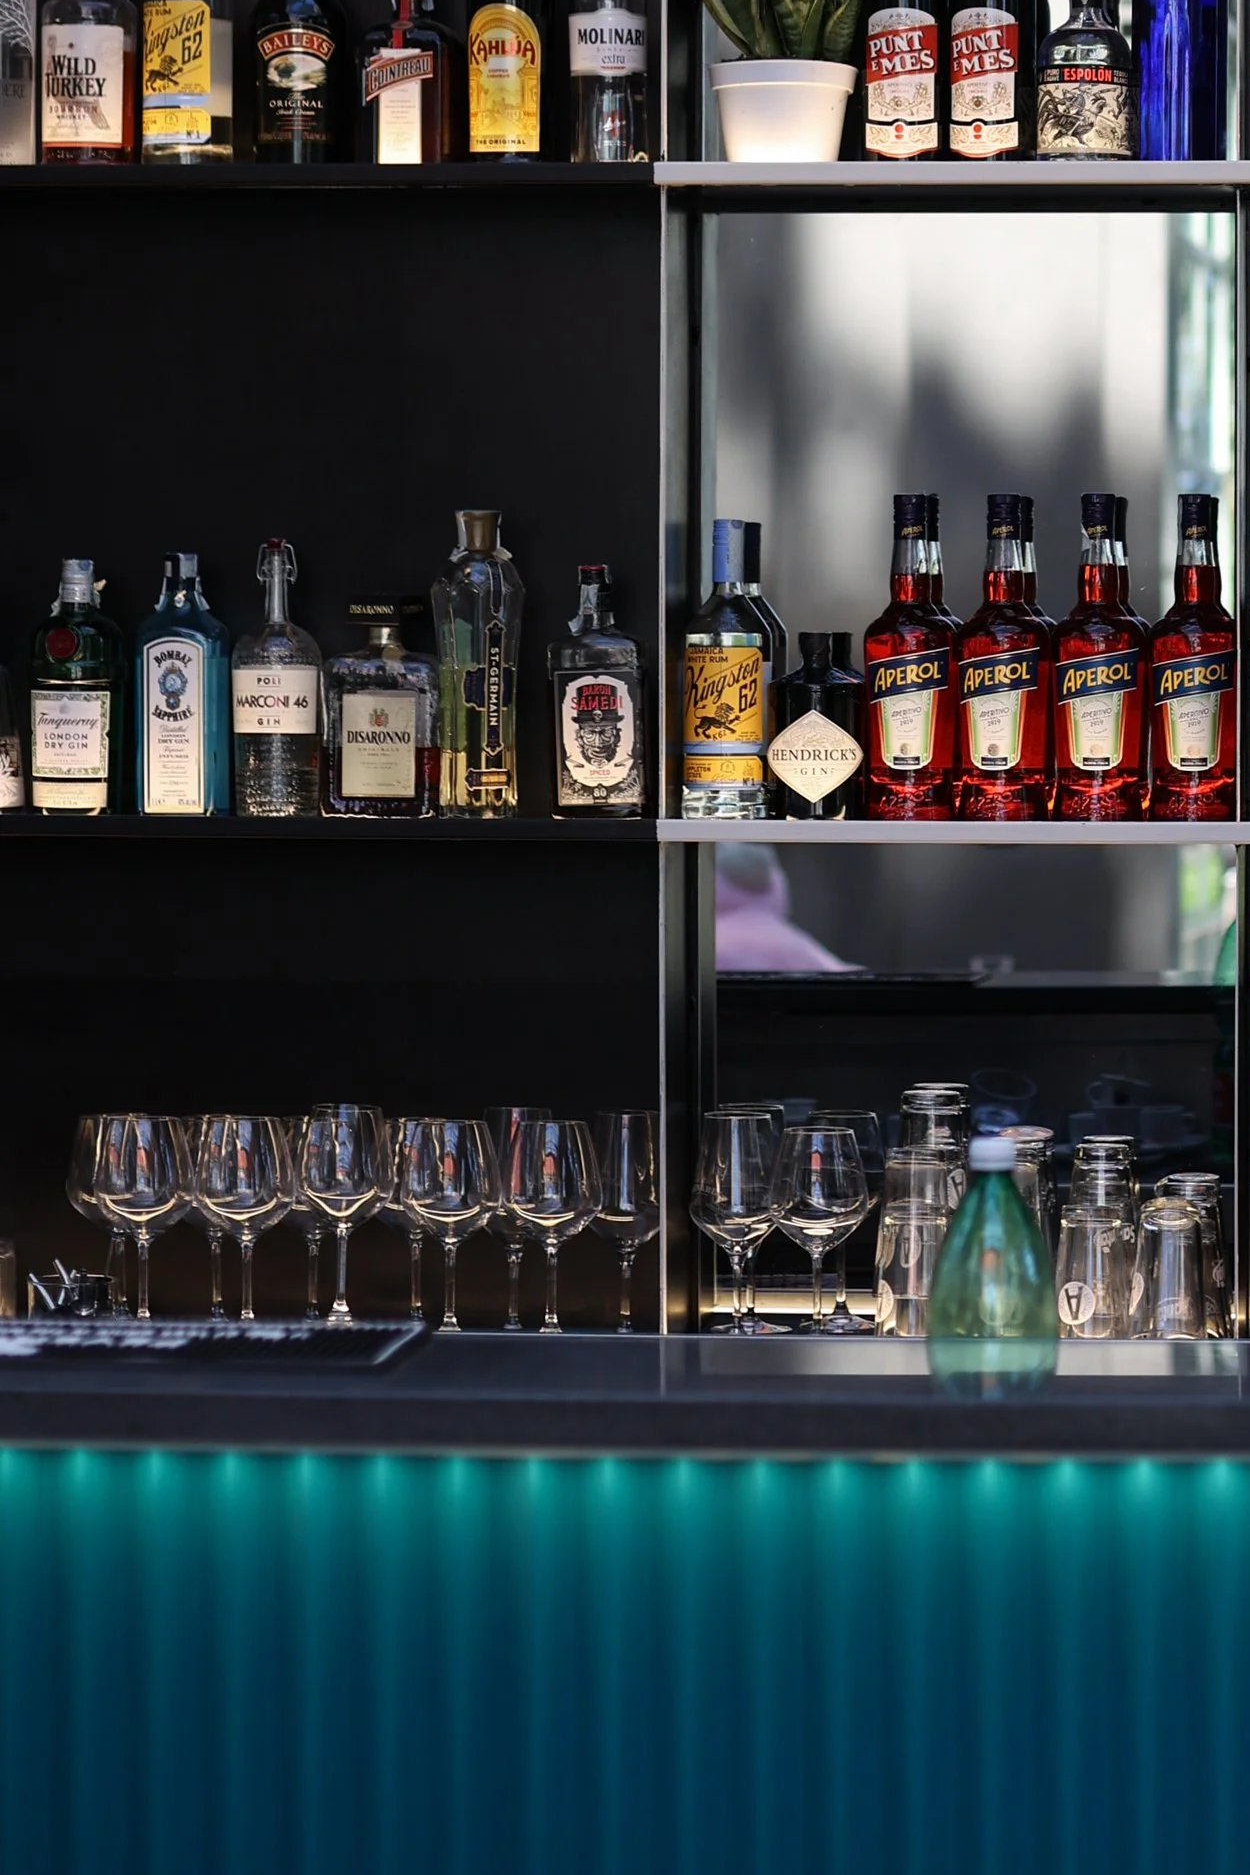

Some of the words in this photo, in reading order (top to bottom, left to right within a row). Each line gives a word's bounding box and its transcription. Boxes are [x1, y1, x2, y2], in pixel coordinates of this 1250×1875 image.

[182, 30, 202, 65] 62
[262, 32, 330, 54] BAILEYS
[578, 28, 645, 46] MOLINARI
[869, 30, 924, 58] PUNT
[952, 30, 1002, 58] PUNT
[51, 55, 96, 75] WILD
[368, 55, 430, 93] COINTREAU
[872, 60, 878, 71] E
[880, 50, 934, 76] MES
[954, 61, 960, 72] E
[961, 49, 1014, 76] MES
[45, 73, 106, 99] TURKEY
[269, 100, 323, 108] ORIGINAL
[350, 604, 394, 614] DISARONNO
[153, 650, 192, 668] BOMBAY
[490, 647, 499, 726] ST-GERMAIN
[686, 657, 759, 713] Kingston
[874, 661, 942, 693] APEROL
[964, 661, 1031, 693] APEROL
[1063, 663, 1131, 695] APEROL
[1160, 664, 1228, 695] APEROL
[236, 695, 289, 708] MARCONI
[294, 695, 308, 708] 46
[571, 696, 623, 710] SAMEDI
[739, 678, 757, 713] 62
[38, 712, 98, 729] Tanqueray
[152, 704, 196, 722] SAPPHIRE
[44, 732, 88, 741] LONDON
[347, 731, 411, 745] DISARONNO
[772, 748, 856, 761] HENDRICK'S
[593, 788, 607, 797] 80
